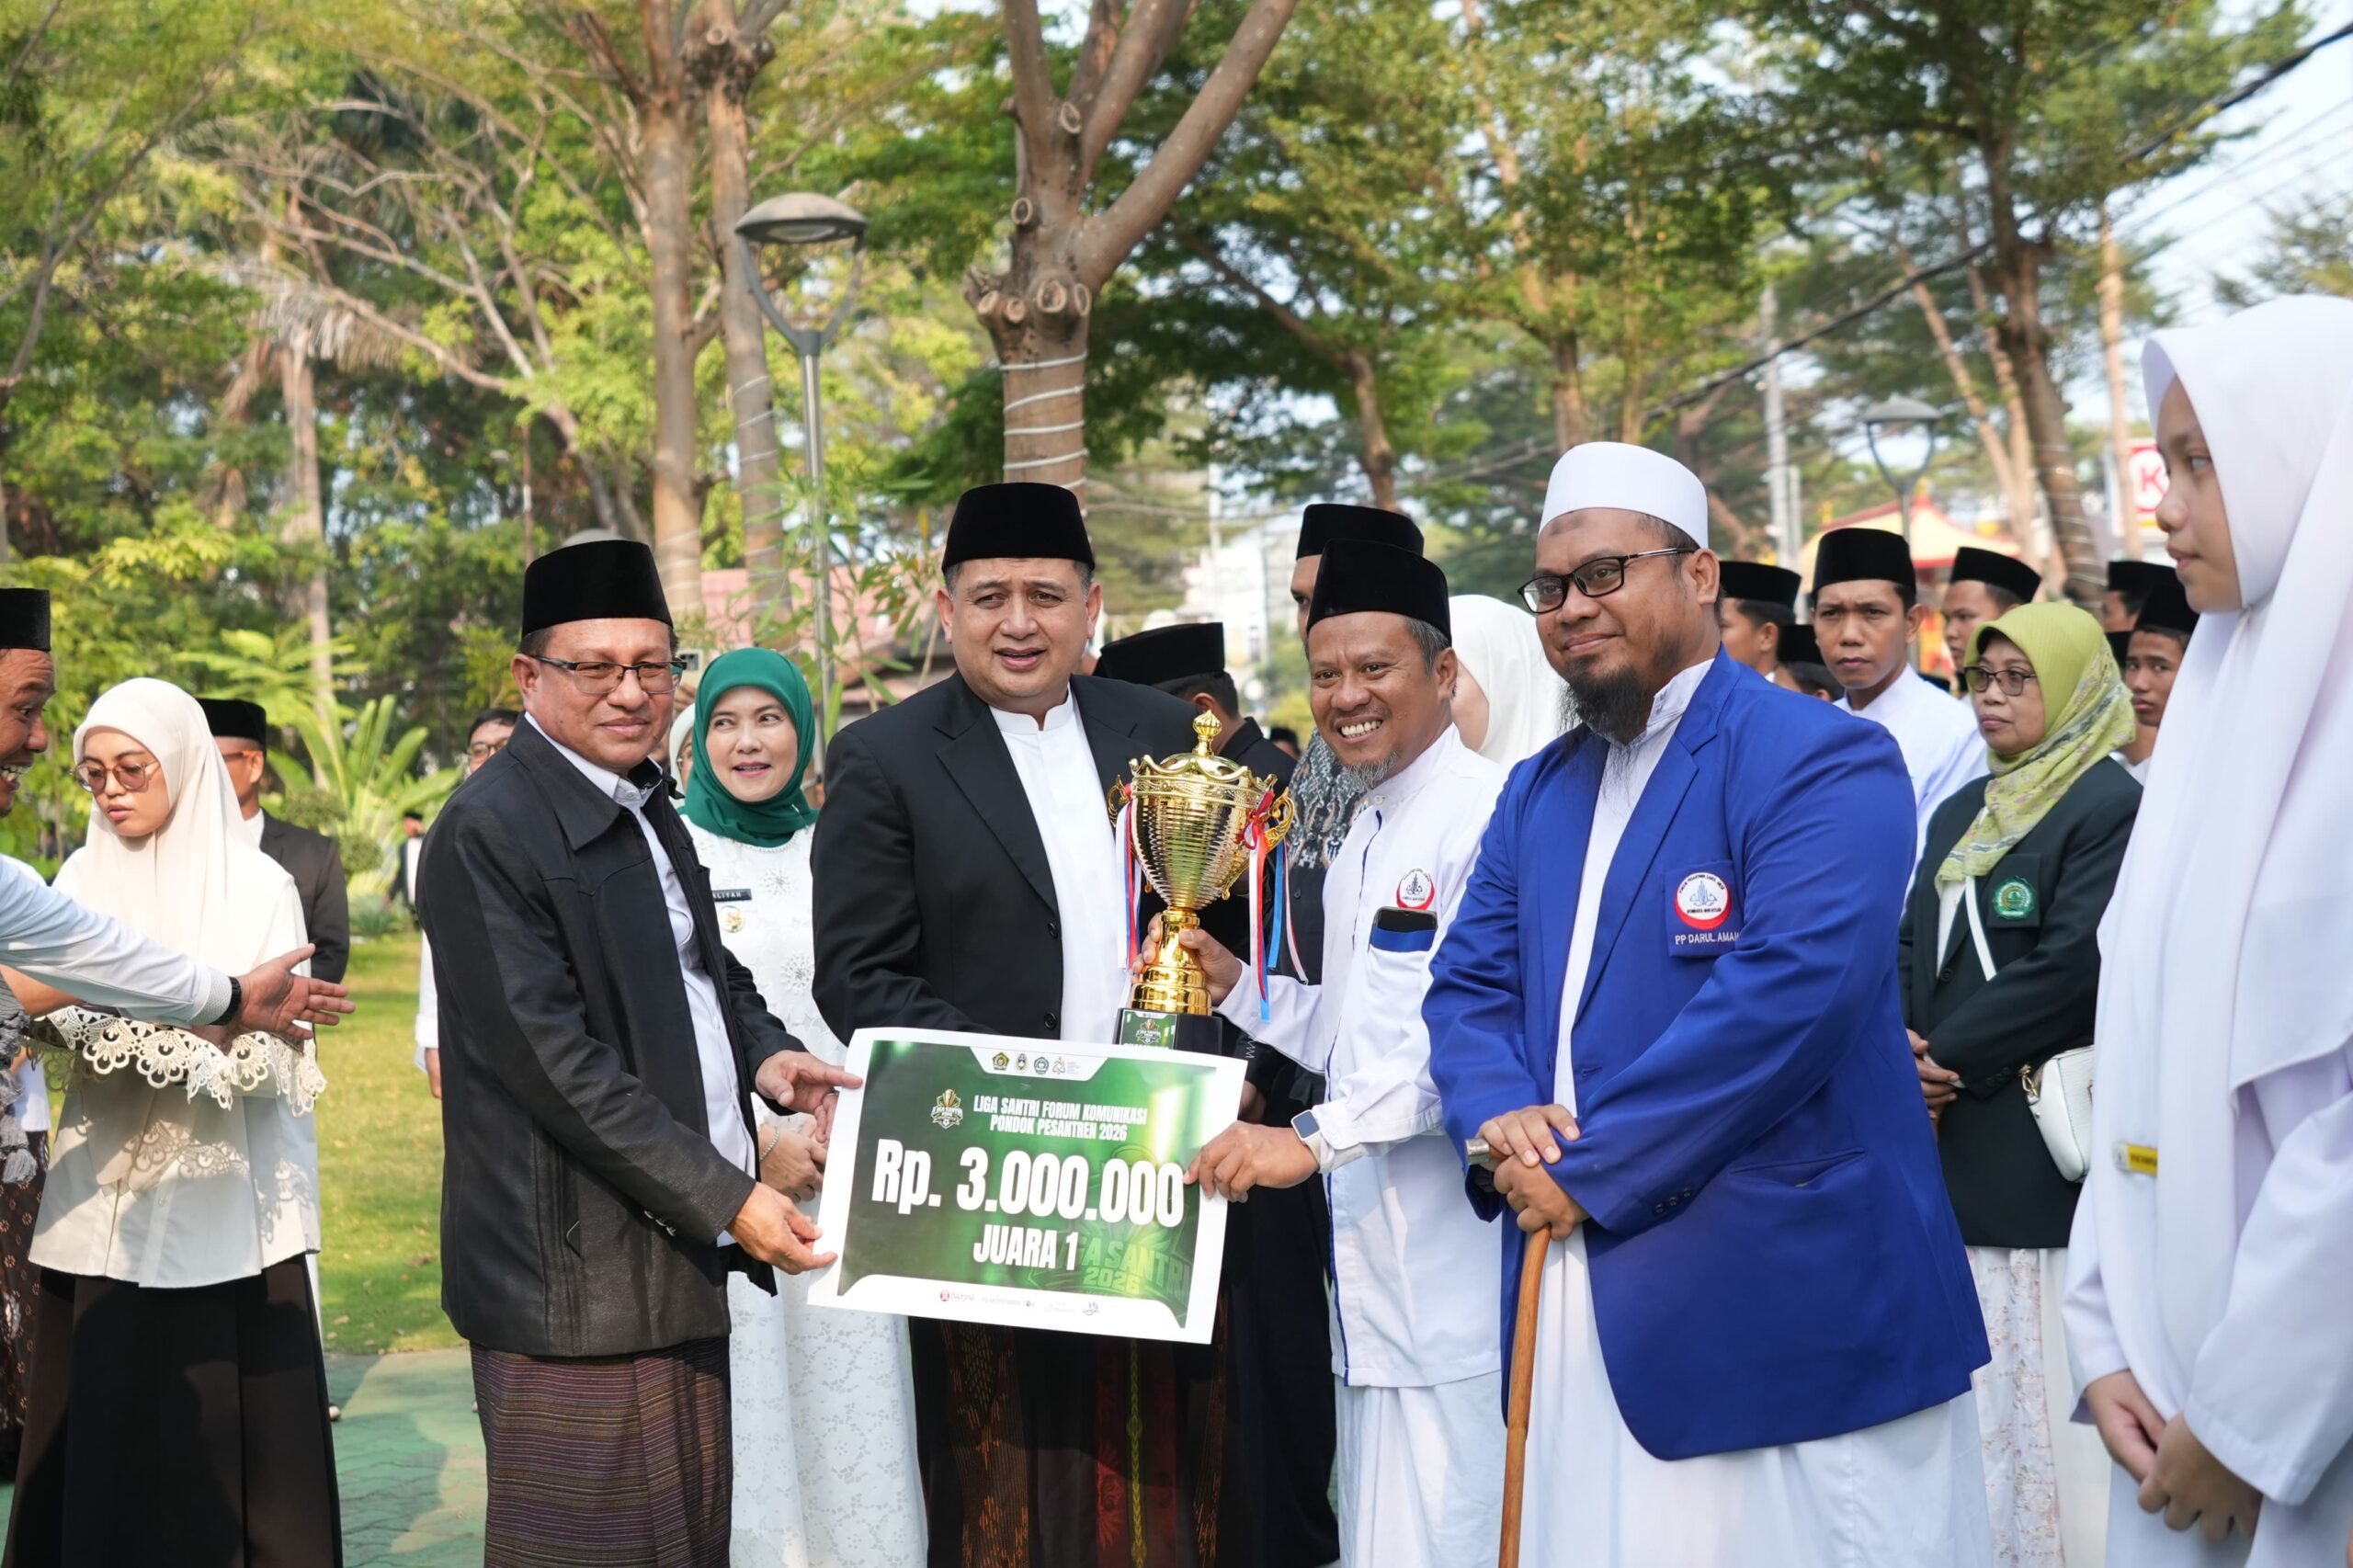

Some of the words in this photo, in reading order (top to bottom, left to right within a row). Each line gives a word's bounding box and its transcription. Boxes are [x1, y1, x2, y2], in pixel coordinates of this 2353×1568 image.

[1675, 934, 1687, 946] PP
[1688, 932, 1717, 944] DARUL
[972, 1095, 998, 1114] LIGA
[1000, 1097, 1040, 1118] SANTRI
[1041, 1101, 1082, 1121] FORUM
[1082, 1104, 1148, 1126] KOMUNIKASI
[989, 1113, 1035, 1135] PONDOK
[1037, 1118, 1097, 1140] PESANTREN
[1098, 1122, 1128, 1142] 2026
[871, 1138, 942, 1215] Rp.
[956, 1146, 1185, 1229] 3.000.000
[972, 1223, 1058, 1269] JUARA
[1065, 1231, 1080, 1271] 1
[1083, 1267, 1142, 1295] 2026
